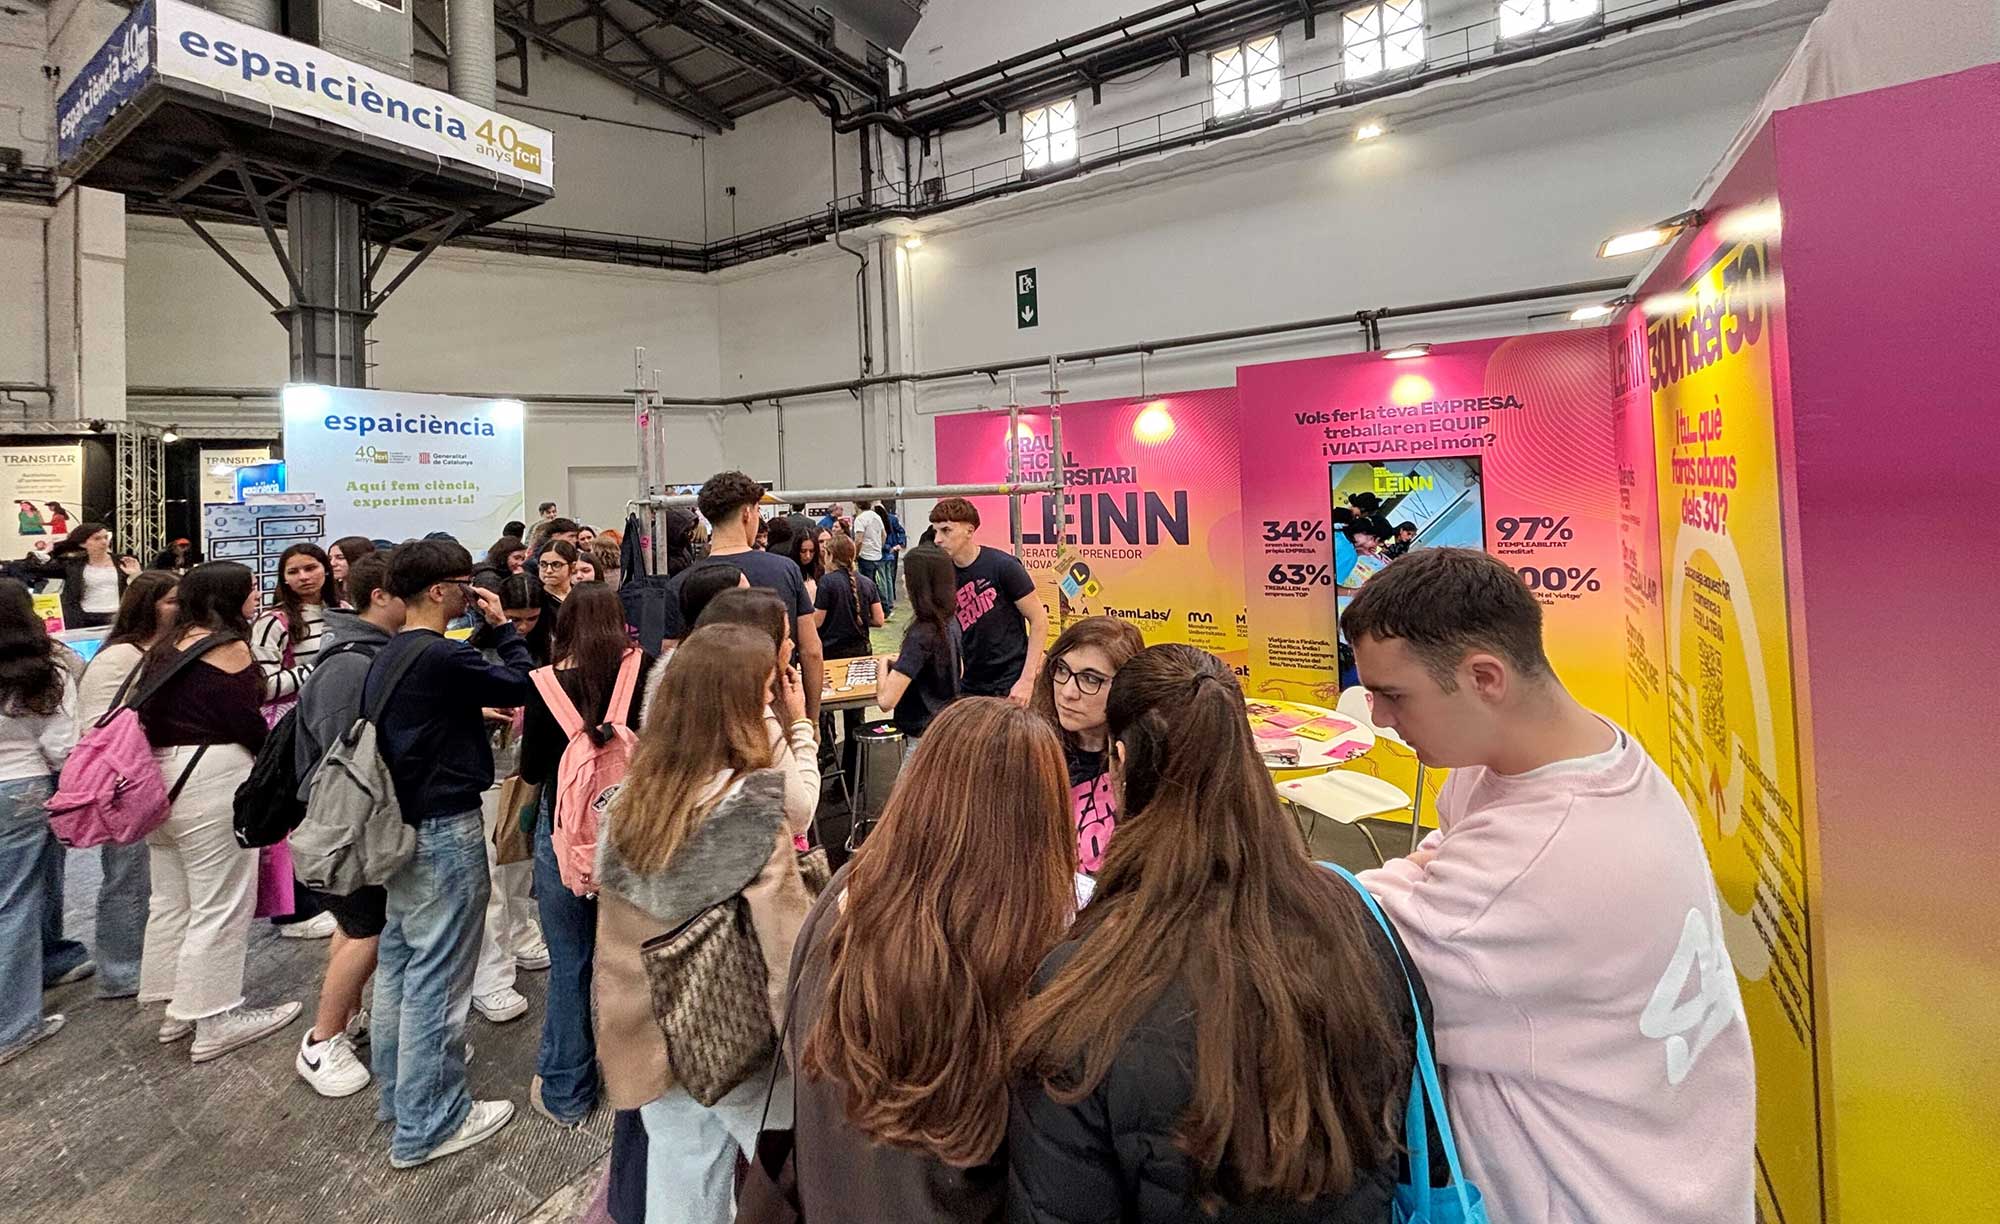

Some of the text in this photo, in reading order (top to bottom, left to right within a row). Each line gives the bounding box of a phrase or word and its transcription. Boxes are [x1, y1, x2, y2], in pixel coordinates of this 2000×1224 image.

[179, 30, 467, 141] espaiciència
[475, 119, 518, 151] 40
[476, 143, 512, 162] anys
[516, 147, 540, 166] fcri
[1295, 395, 1523, 425] Vols fer la teva EMPRESA,
[324, 413, 495, 436] espaiciència
[1324, 416, 1490, 439] treballar en EQUIP
[1699, 394, 1722, 457] què
[1329, 438, 1408, 455] VIATJAR
[1411, 437, 1438, 454] pel
[1442, 433, 1497, 449] món?
[3, 454, 76, 463] TRANSITAR
[1672, 446, 1737, 489] faràs abans
[346, 480, 480, 493] Aquí fem ciència,
[1374, 475, 1434, 493] LEINN
[353, 495, 475, 508] experimenta-la!
[1682, 488, 1702, 528] dels
[1703, 491, 1728, 536] 30?
[1010, 491, 1190, 545] LEINN
[1496, 516, 1573, 540] 97%
[1262, 521, 1326, 541] 34%
[1268, 564, 1331, 585] 63%
[1511, 567, 1601, 592] 00%
